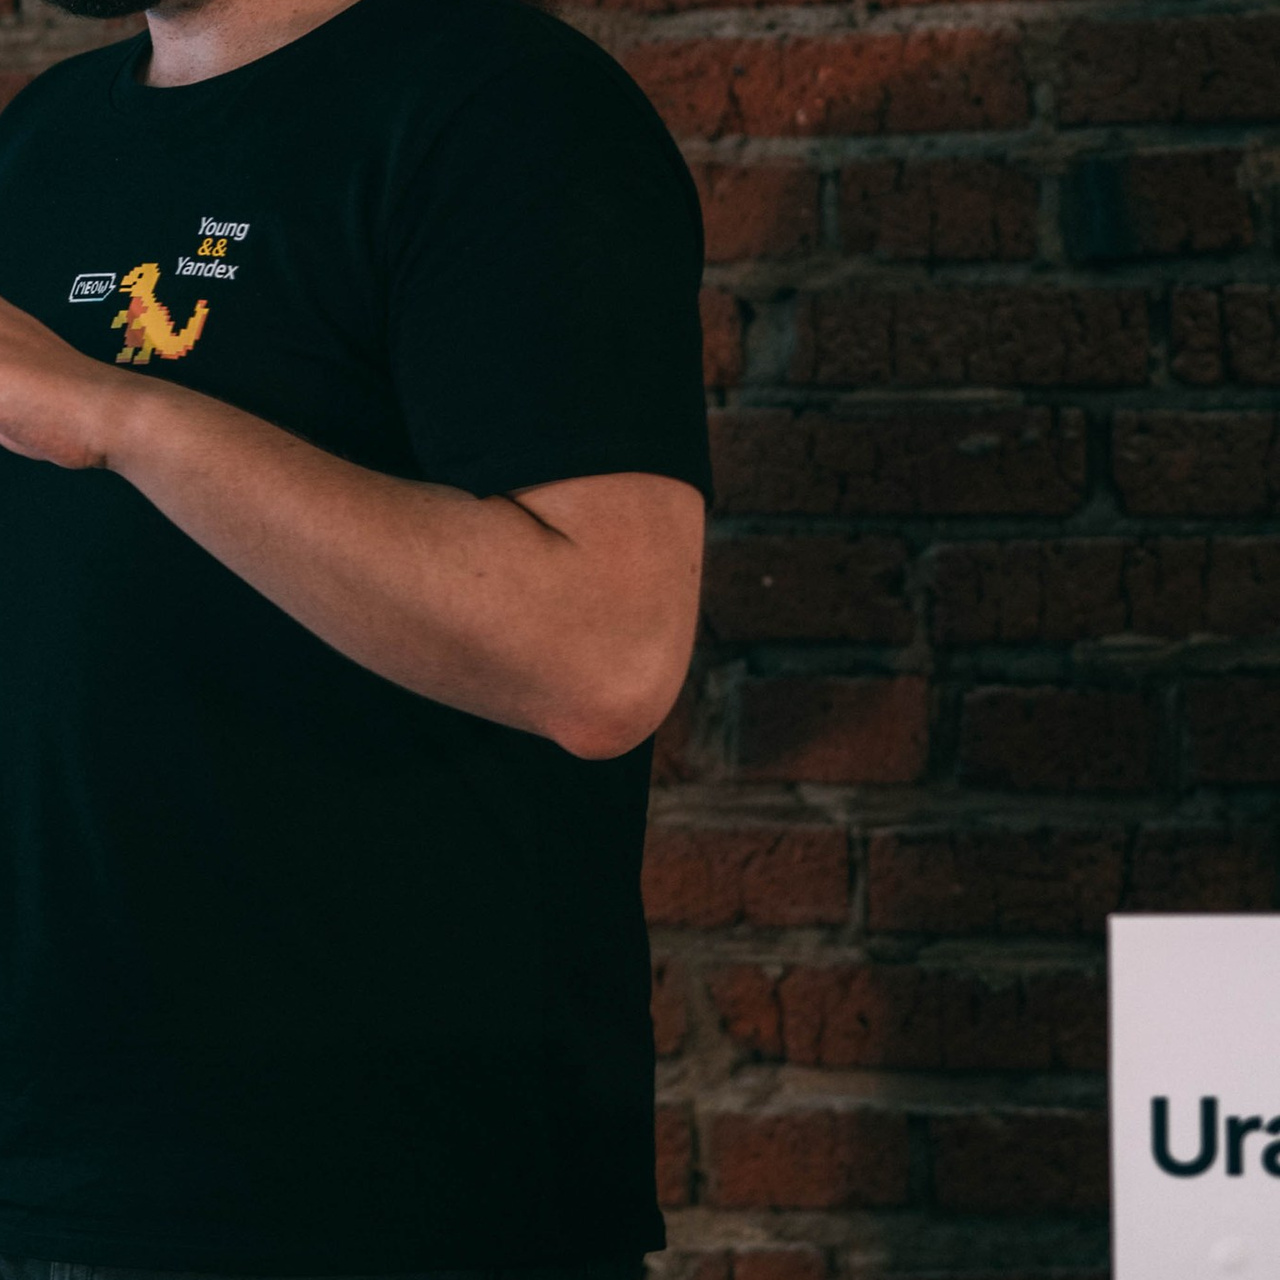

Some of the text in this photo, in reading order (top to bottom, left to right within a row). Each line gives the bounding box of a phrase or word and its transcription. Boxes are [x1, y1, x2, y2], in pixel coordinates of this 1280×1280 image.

[198, 217, 250, 241] Young
[197, 238, 228, 257] &&
[174, 257, 239, 280] Yandex
[74, 280, 110, 295] MEOW
